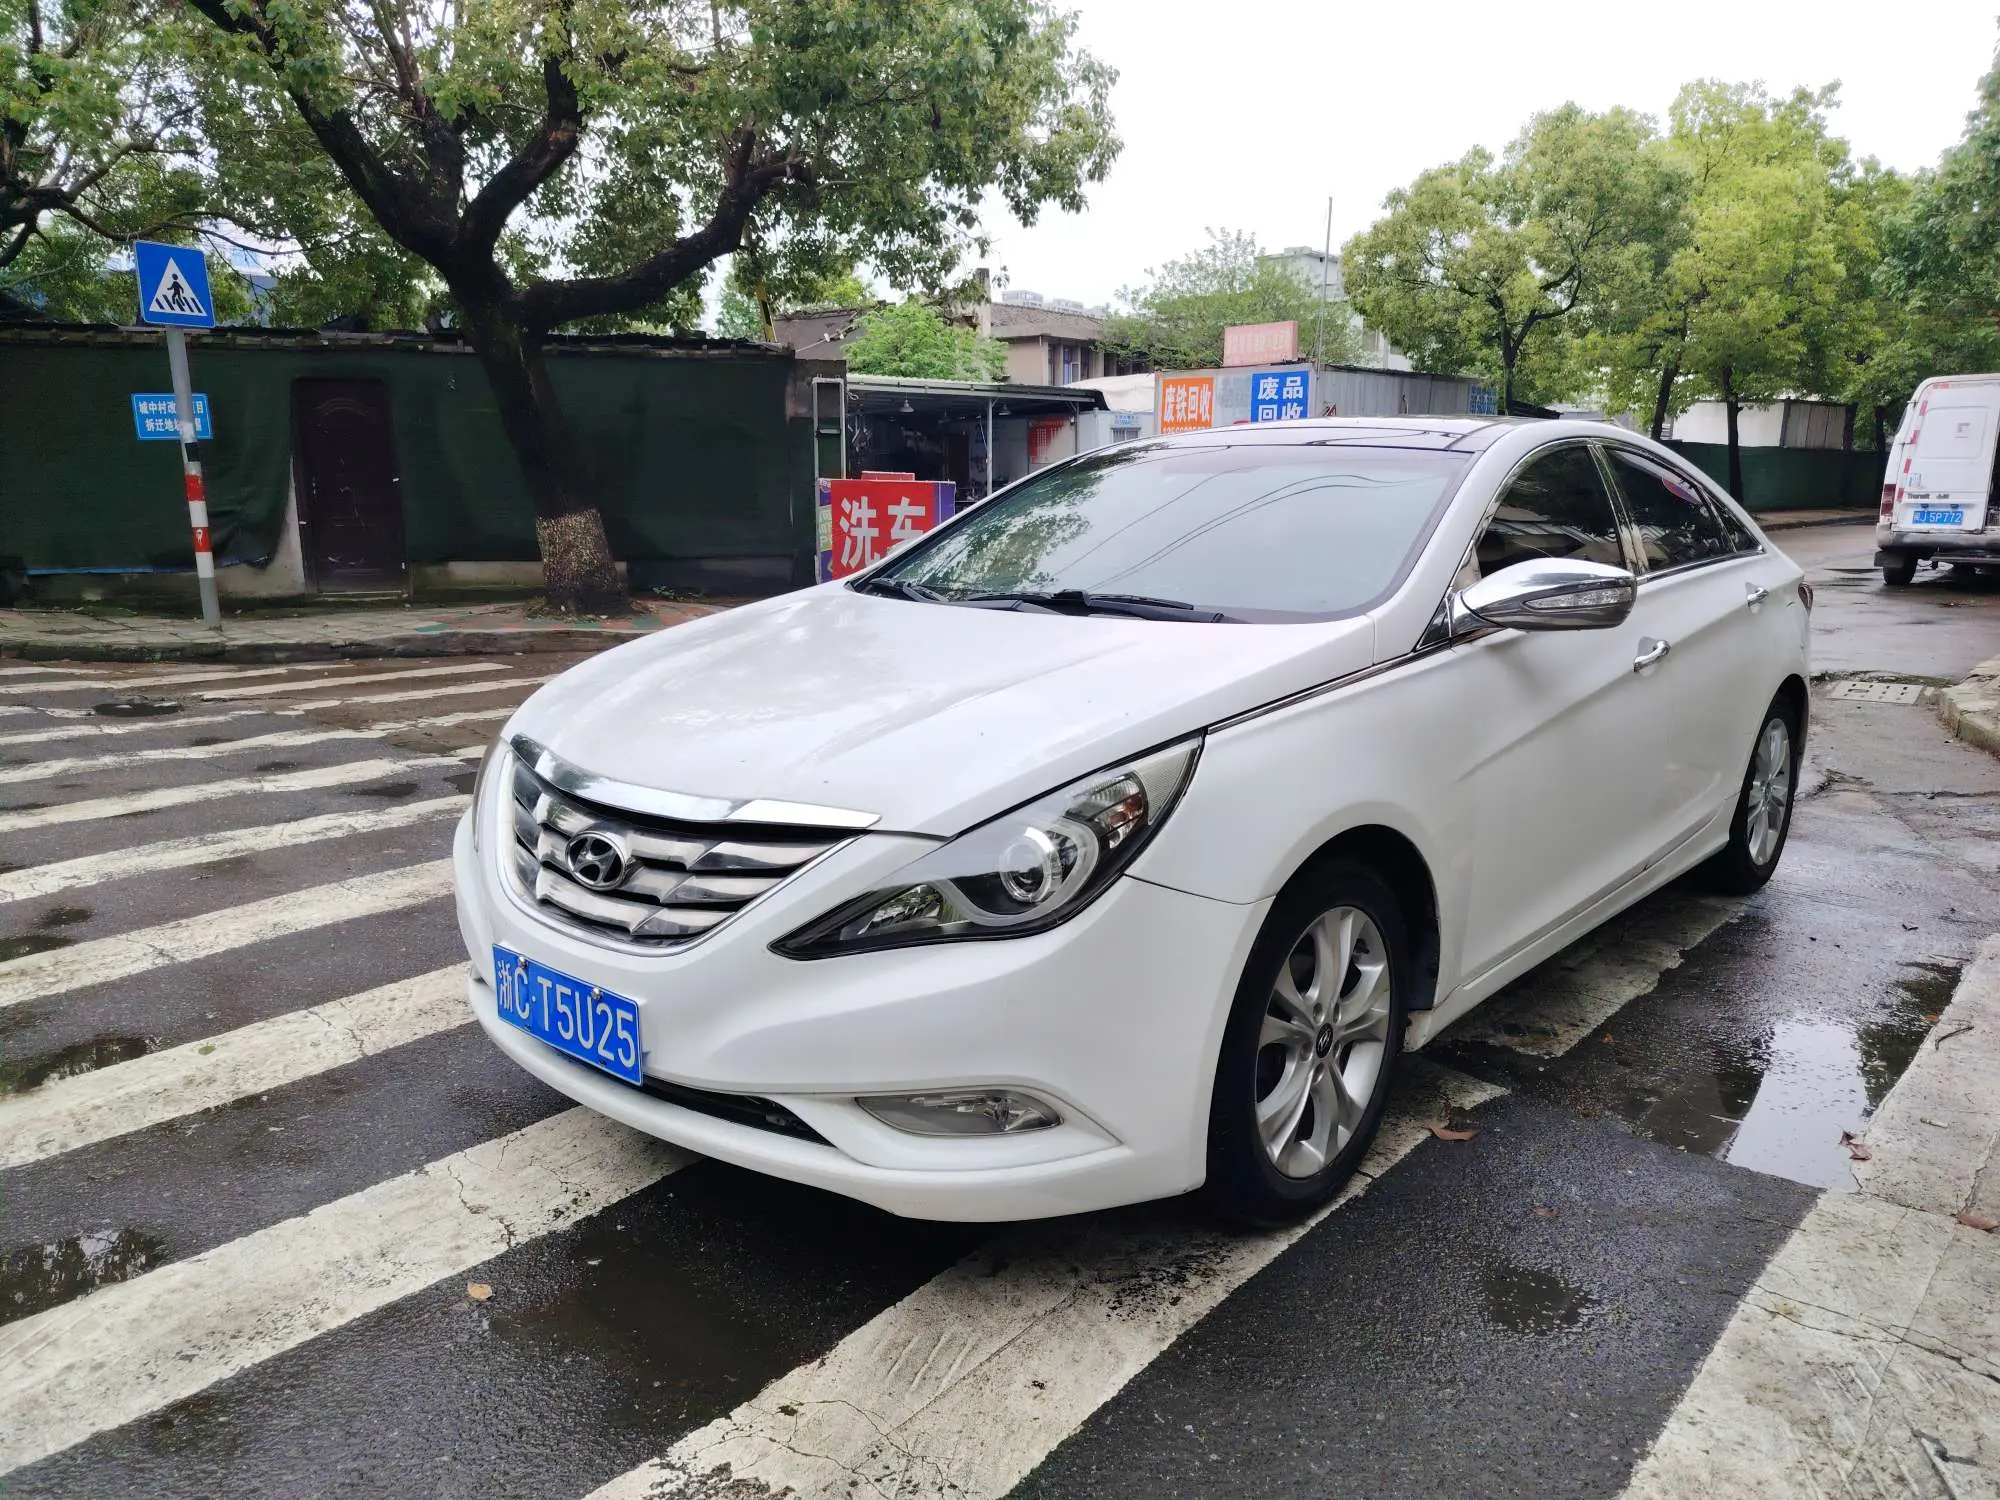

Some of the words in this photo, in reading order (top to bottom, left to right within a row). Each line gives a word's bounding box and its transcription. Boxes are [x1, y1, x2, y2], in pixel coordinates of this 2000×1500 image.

[1258, 376, 1304, 400] 废品
[139, 400, 203, 414] 城中村改目
[1163, 383, 1212, 422] 废铁回收
[1258, 402, 1303, 423] 回收
[840, 496, 926, 568] 洗车
